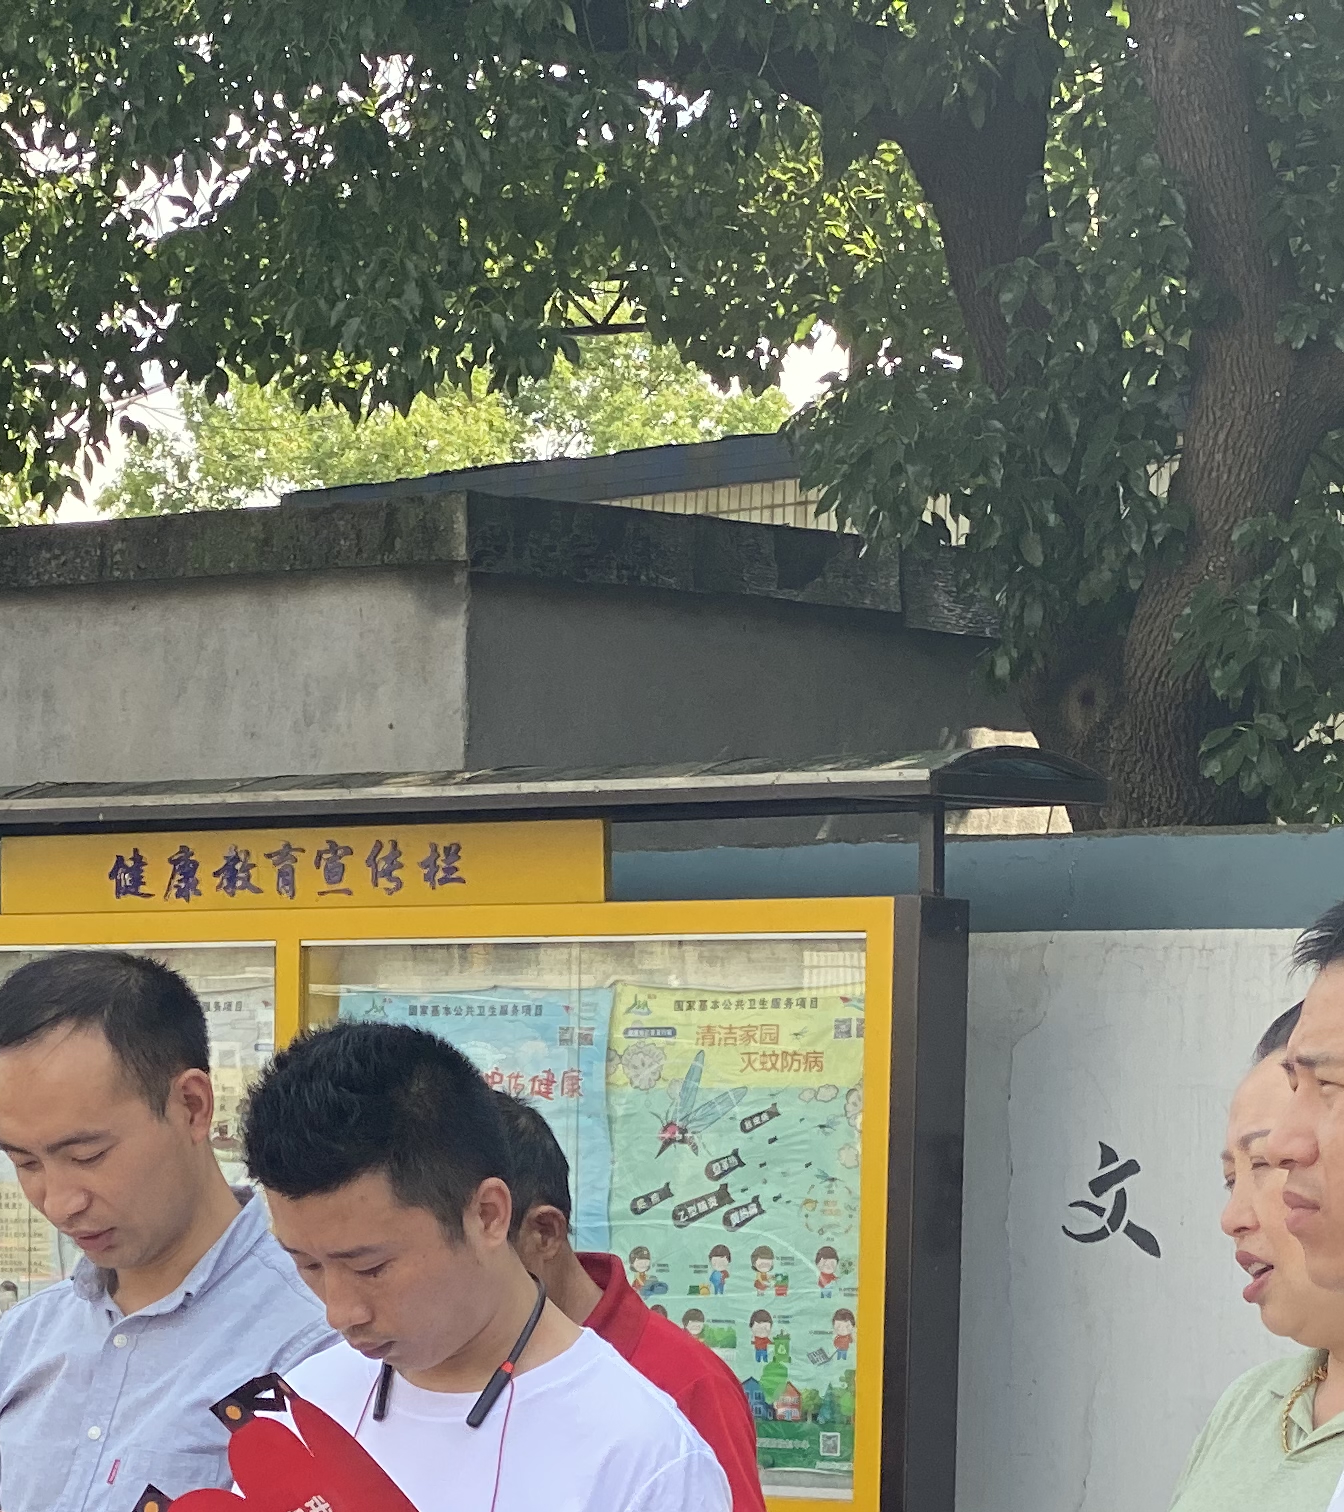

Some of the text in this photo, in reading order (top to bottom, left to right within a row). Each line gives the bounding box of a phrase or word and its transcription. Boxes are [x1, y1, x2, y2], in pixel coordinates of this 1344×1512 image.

[107, 840, 467, 902] 健康教育宣传栏
[408, 1004, 544, 1017] 国家基本公共卫生服务项目
[673, 997, 818, 1012] 国家基本公共卫生服务项目
[695, 1024, 780, 1047] 清洁家园
[740, 1051, 824, 1073] 灭蚊防病
[1062, 1140, 1161, 1258] 文
